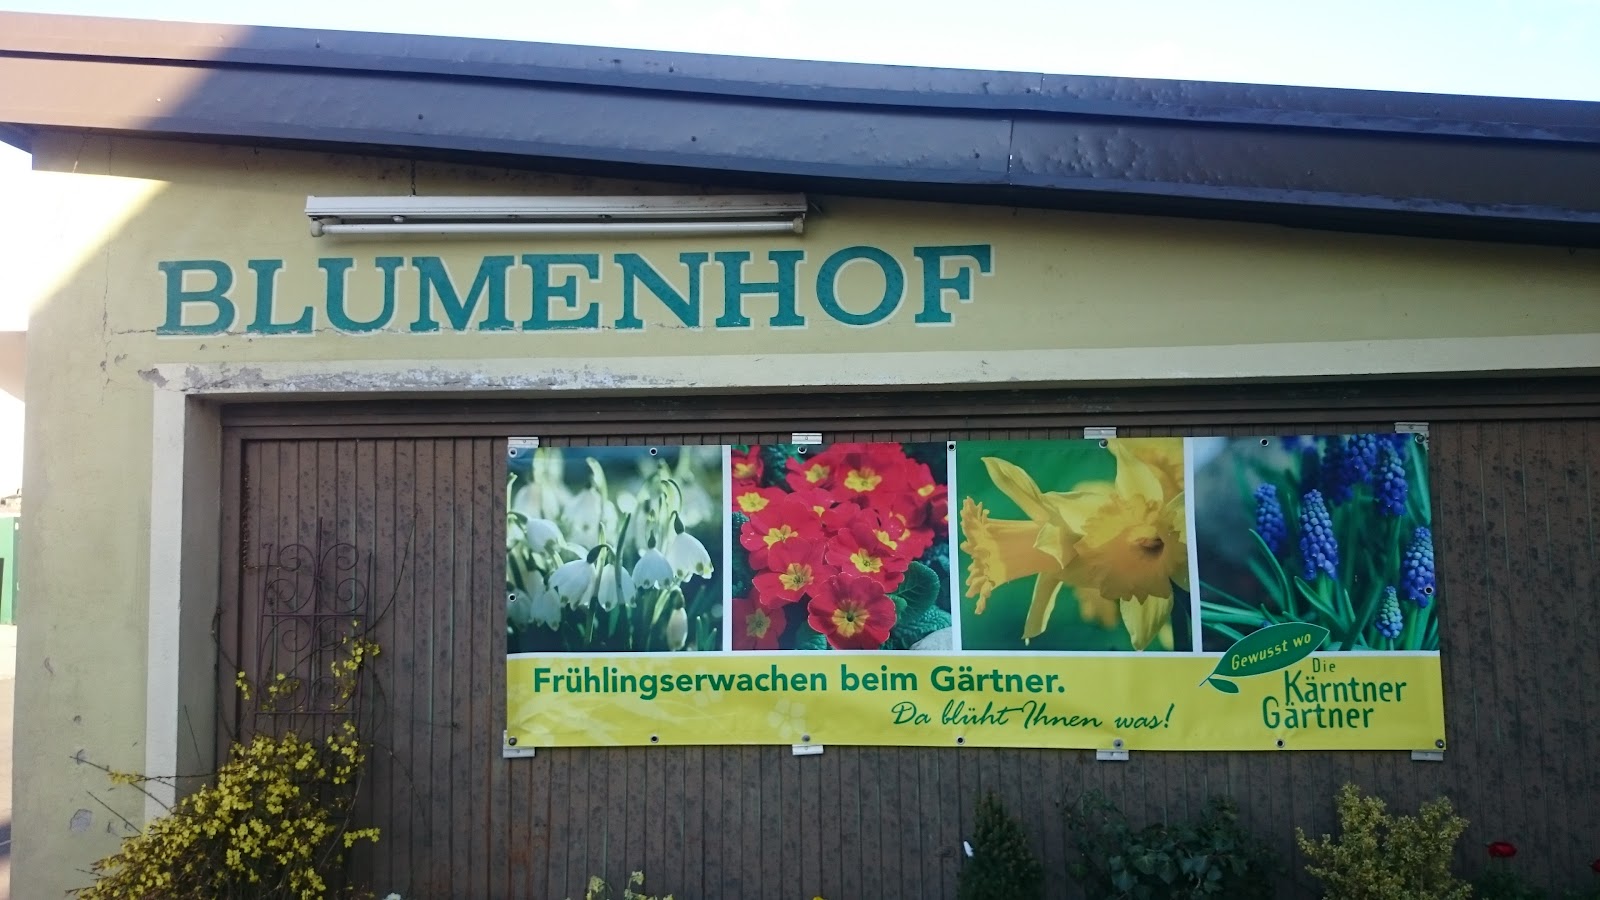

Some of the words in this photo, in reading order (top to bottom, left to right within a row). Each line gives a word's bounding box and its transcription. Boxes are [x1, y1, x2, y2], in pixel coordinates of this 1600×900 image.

[157, 244, 992, 336] BLUMENHOF
[1231, 640, 1289, 671] Gewusst
[1293, 633, 1312, 648] wo
[1312, 657, 1336, 673] Die
[533, 664, 828, 700] Frühlingserwachen
[841, 664, 918, 692] beim
[930, 665, 1066, 693] Gärtner.
[1284, 669, 1408, 704] Kärntner
[891, 700, 932, 726] Da
[941, 698, 1022, 726] blüht
[1021, 699, 1103, 729] Ihnen
[1114, 703, 1176, 730] was!
[1262, 695, 1375, 730] Gärtner
